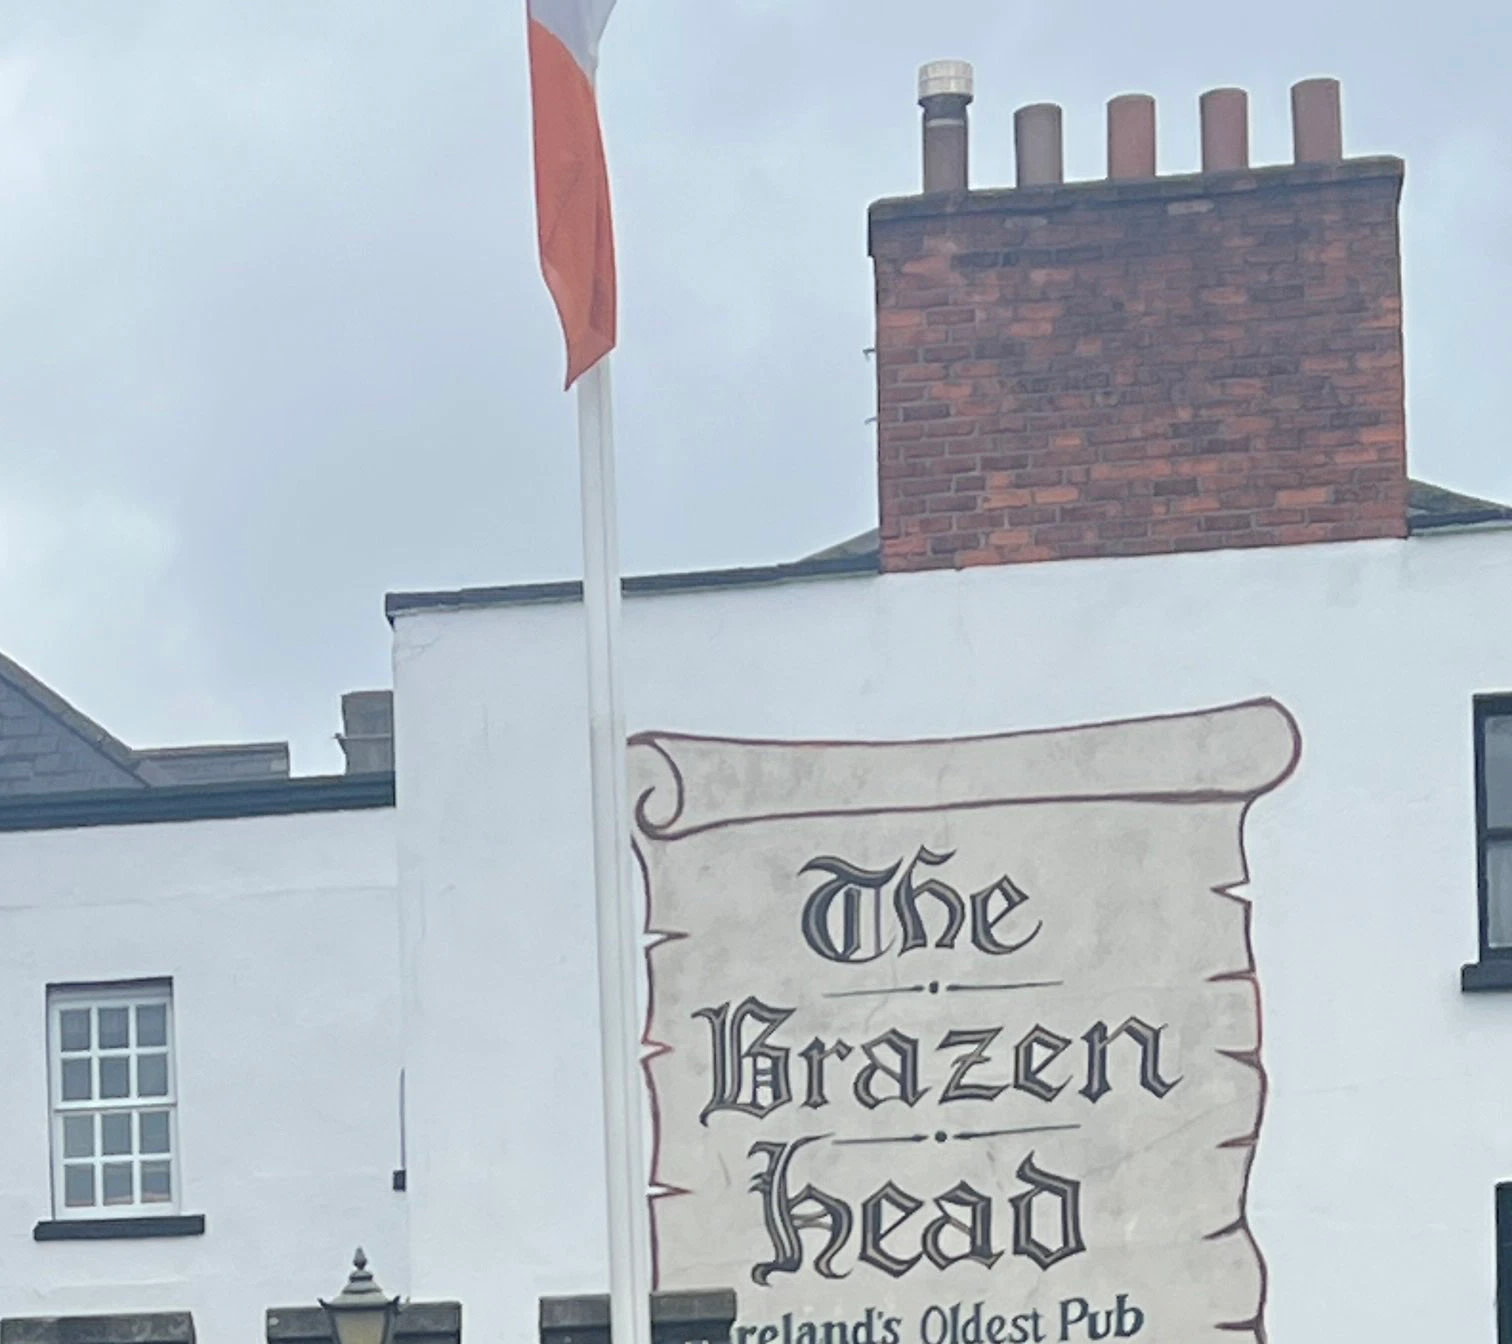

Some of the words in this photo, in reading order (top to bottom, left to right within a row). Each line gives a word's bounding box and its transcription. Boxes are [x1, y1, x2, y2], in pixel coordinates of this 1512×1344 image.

[797, 845, 1042, 964] The
[691, 996, 1183, 1127] Brazen
[1058, 1294, 1146, 1342] Pub
